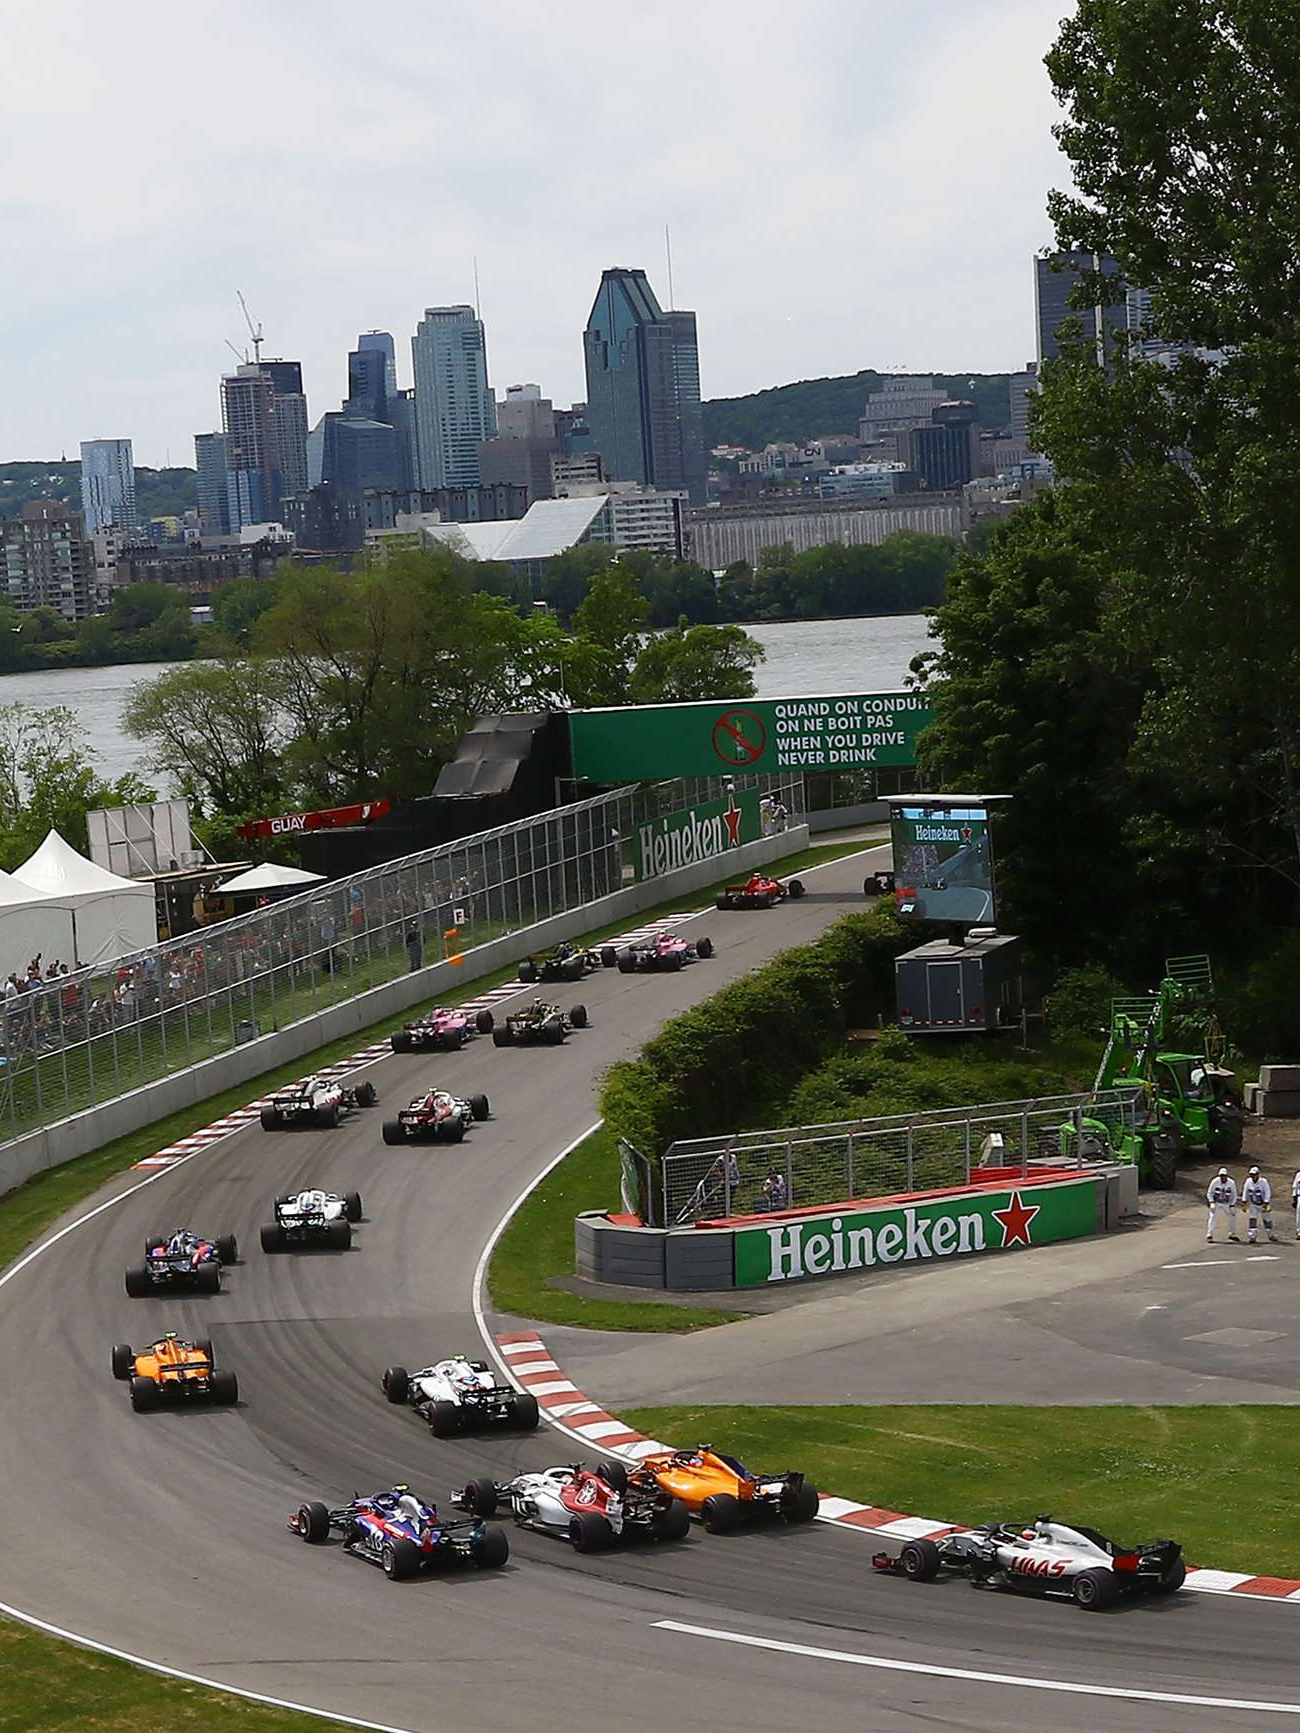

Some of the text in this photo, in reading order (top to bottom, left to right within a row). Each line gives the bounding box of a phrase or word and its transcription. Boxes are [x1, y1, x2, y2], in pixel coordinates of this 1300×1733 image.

[803, 447, 821, 457] CN
[775, 703, 829, 719] QUAND
[835, 701, 858, 714] ON
[776, 714, 893, 733] ON NE BOIT PAS
[776, 732, 905, 750] WHEN YOU DRIVE
[778, 749, 876, 766] NEVER DRINK
[271, 816, 306, 834] GUAY
[915, 824, 960, 841] Heineken
[640, 811, 723, 880] Heineken
[766, 1209, 987, 1281] Heineken
[1008, 1556, 1074, 1578] HAAS
